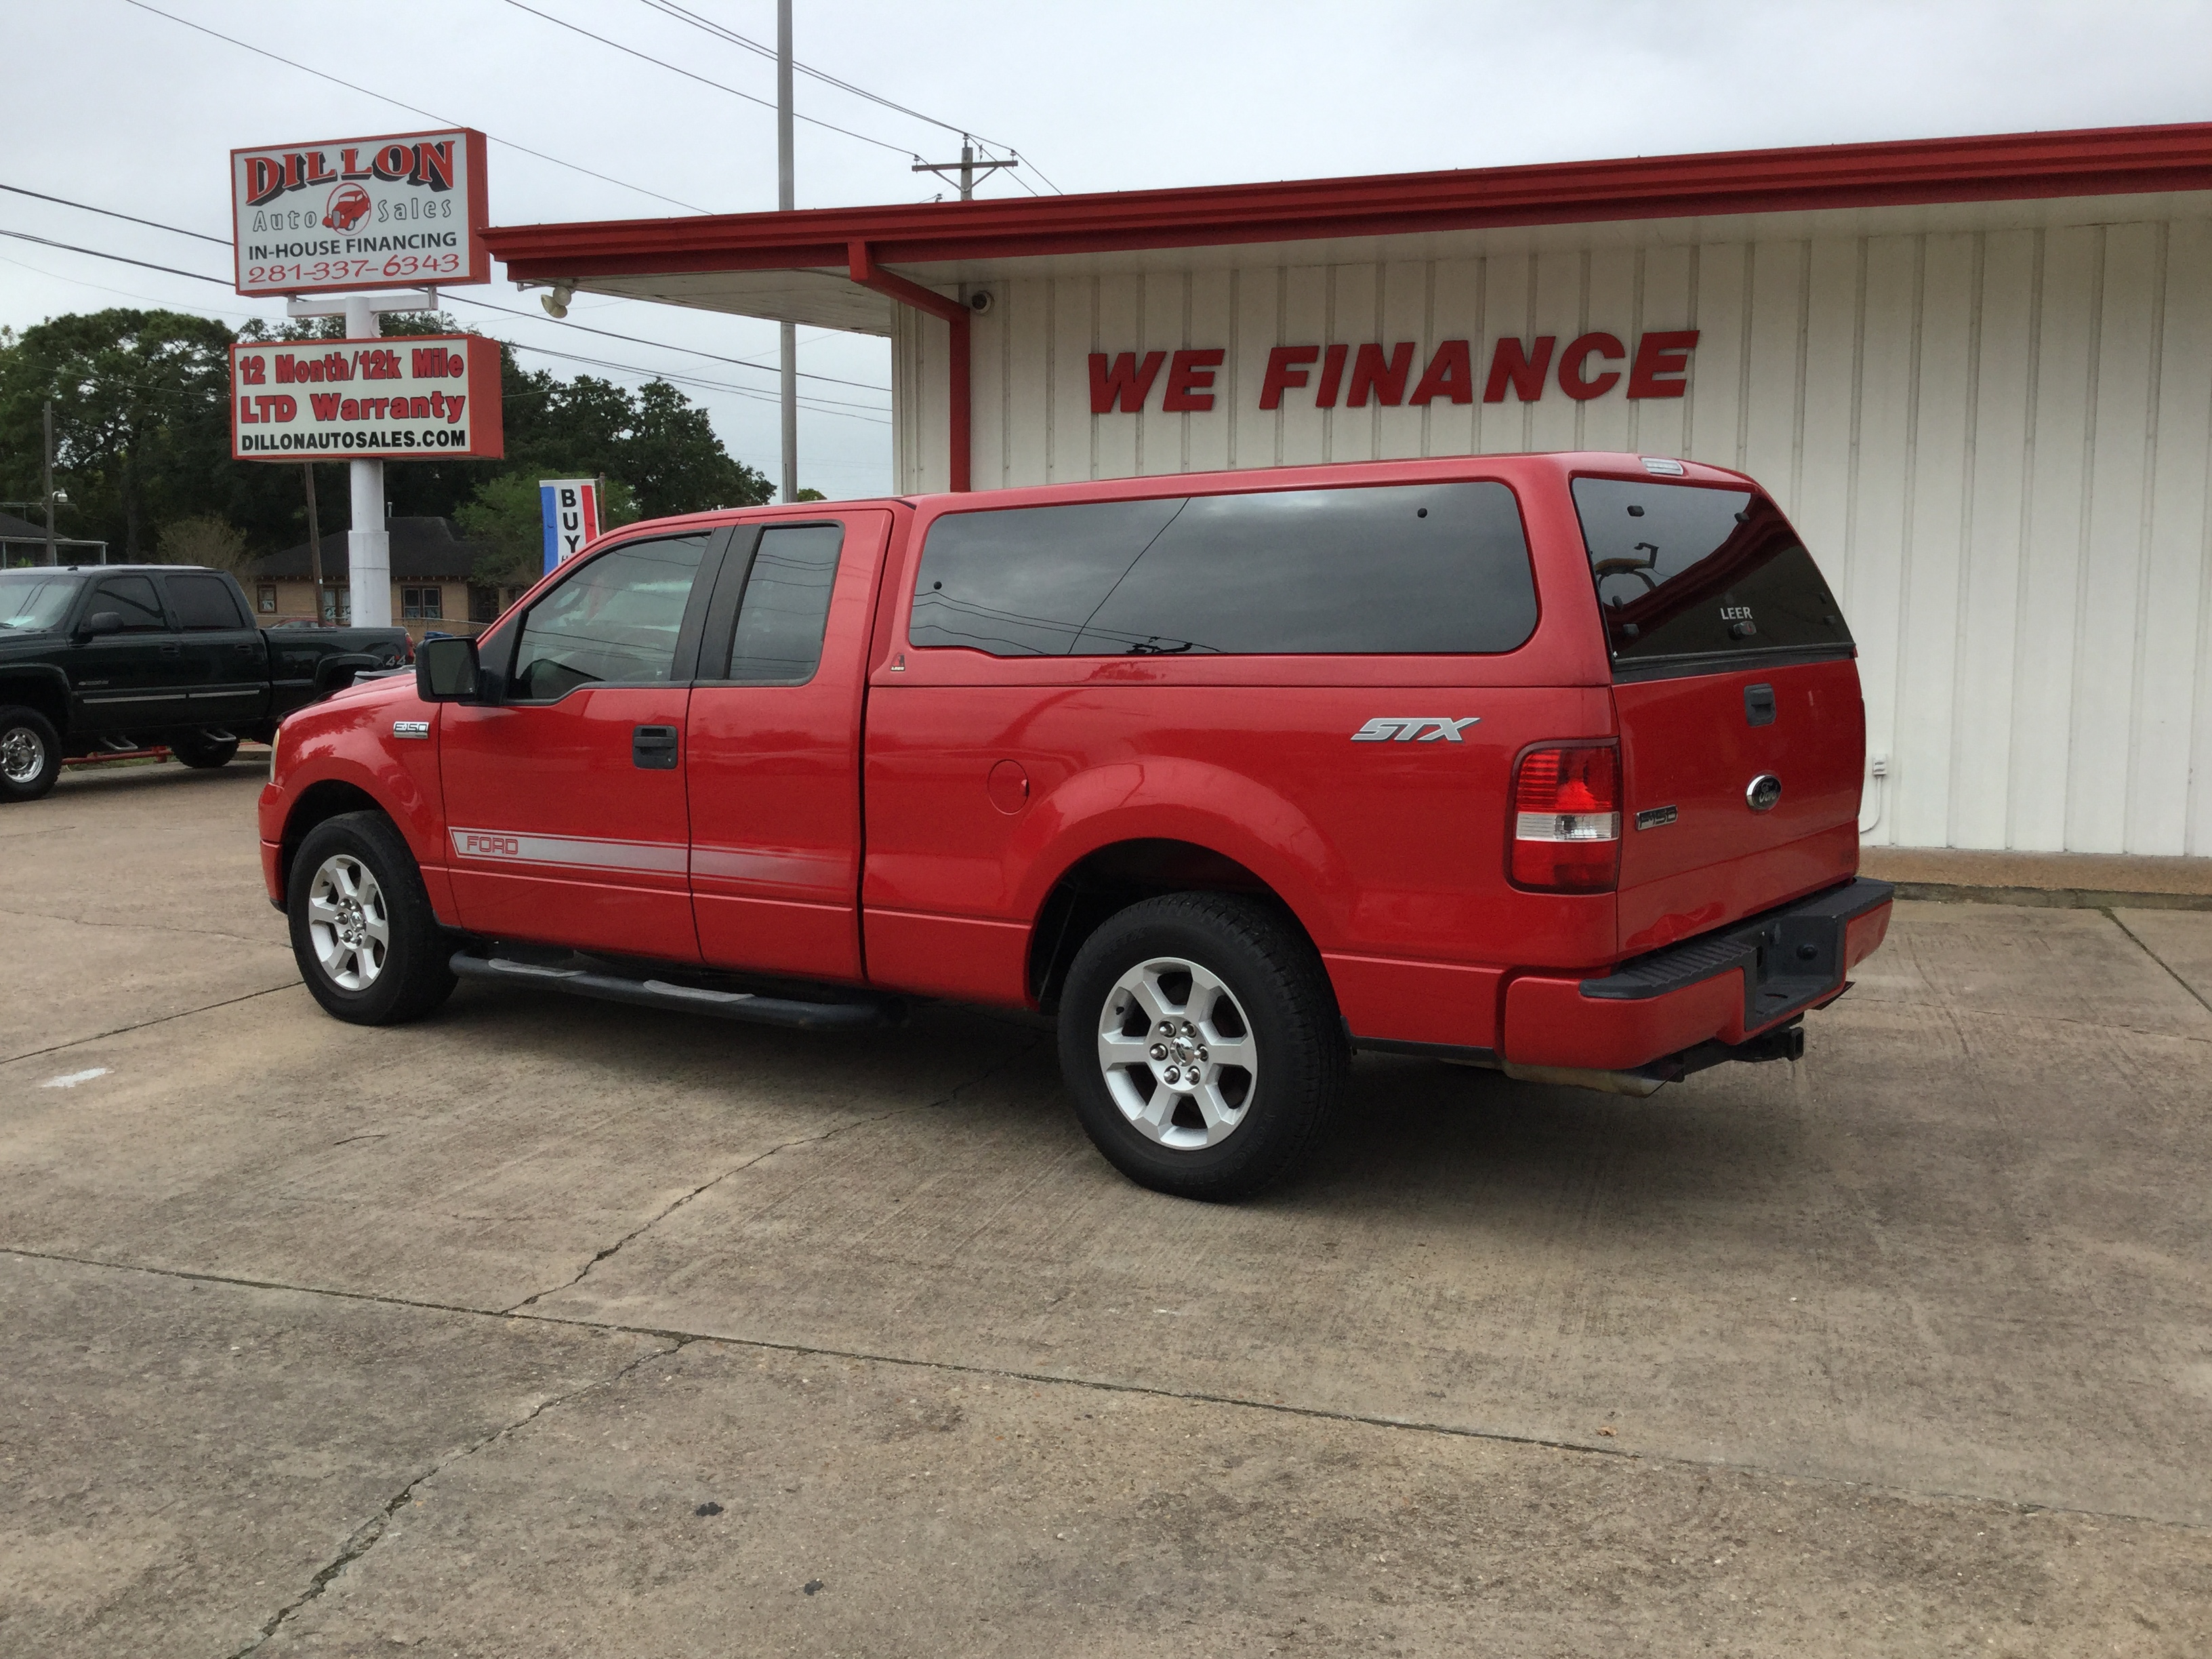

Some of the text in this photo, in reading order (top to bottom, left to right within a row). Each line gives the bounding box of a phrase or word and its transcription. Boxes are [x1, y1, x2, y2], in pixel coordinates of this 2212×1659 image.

[244, 140, 455, 206] DILLON
[252, 197, 451, 232] Auto Sales
[249, 232, 457, 260] IN-HOUSE FINANCING
[248, 253, 459, 283] 281-337-6343
[239, 347, 464, 385] 12 Month/12k Mile
[1087, 329, 1700, 414] WE FINANCE
[241, 391, 466, 424] LTD Warranty
[241, 430, 466, 451] DILLONAUTOSALES.COM
[561, 489, 580, 554] BUY
[1719, 607, 1753, 620] LEER
[1350, 717, 1481, 743] STX
[467, 836, 518, 855] FORD
